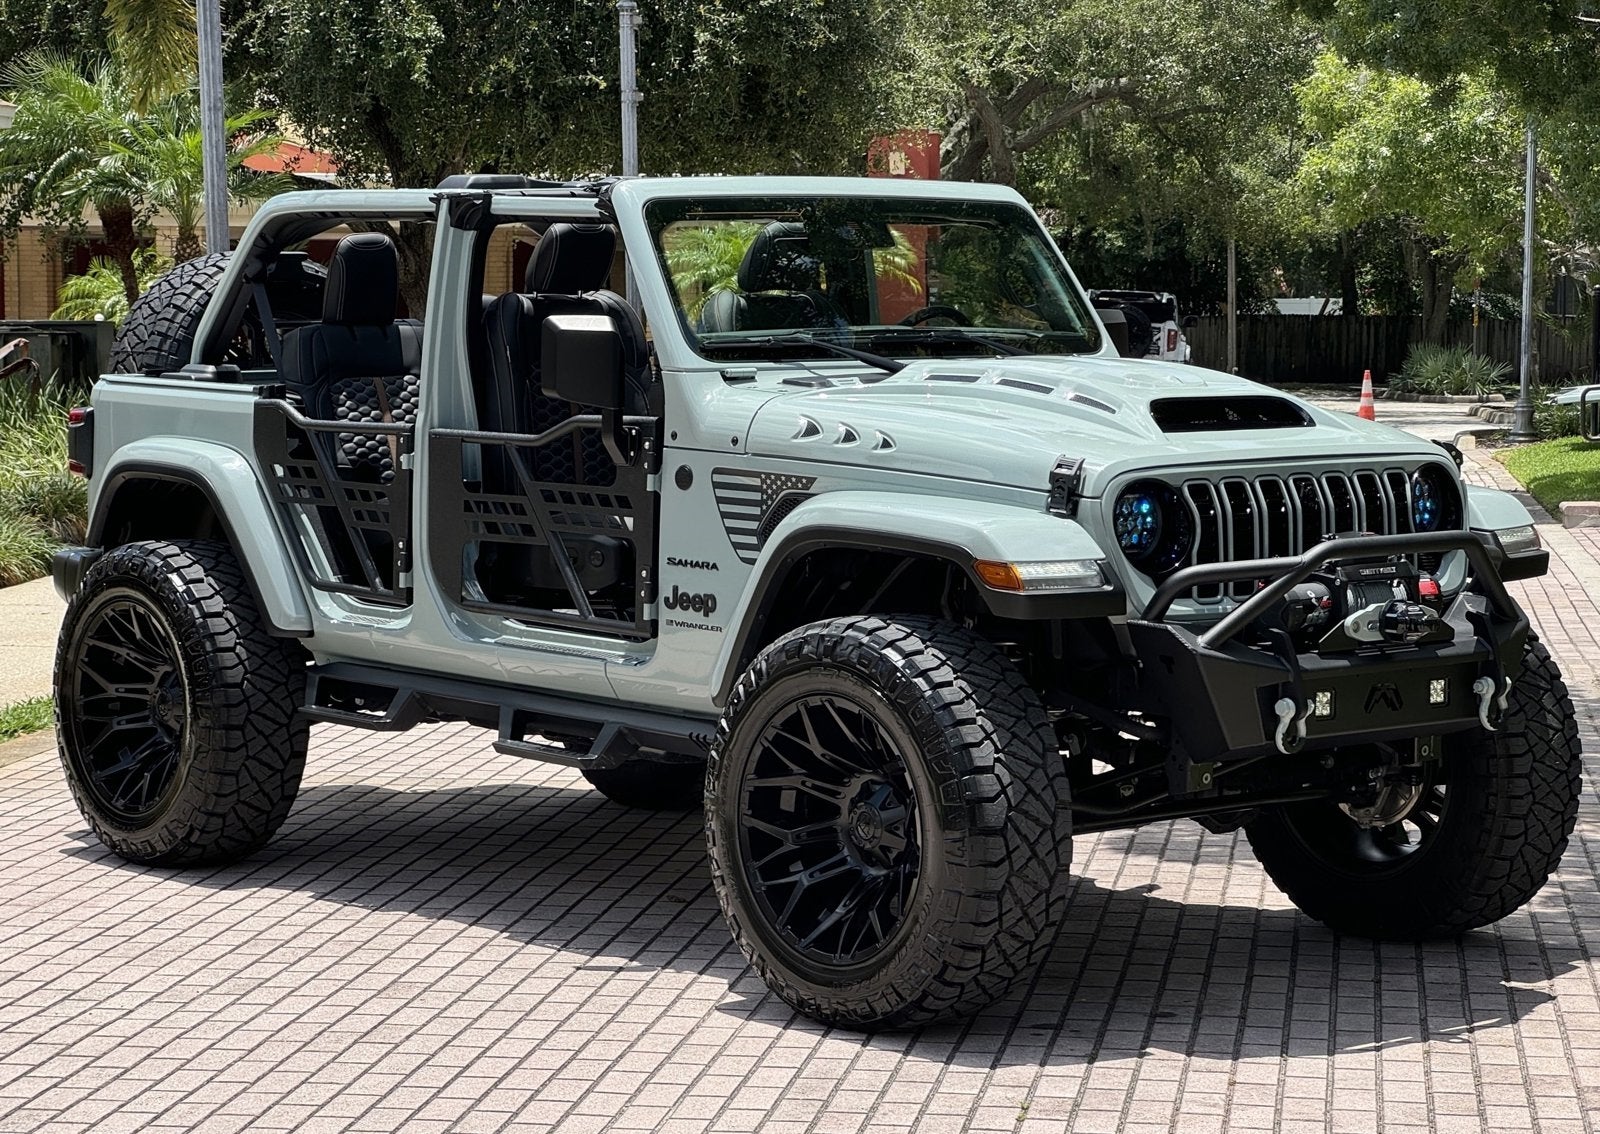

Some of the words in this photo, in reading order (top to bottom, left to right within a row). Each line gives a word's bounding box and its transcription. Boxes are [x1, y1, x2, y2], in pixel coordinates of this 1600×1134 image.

[667, 557, 719, 571] SAHARA
[664, 585, 717, 617] Jeep
[675, 620, 723, 632] WRANGLER
